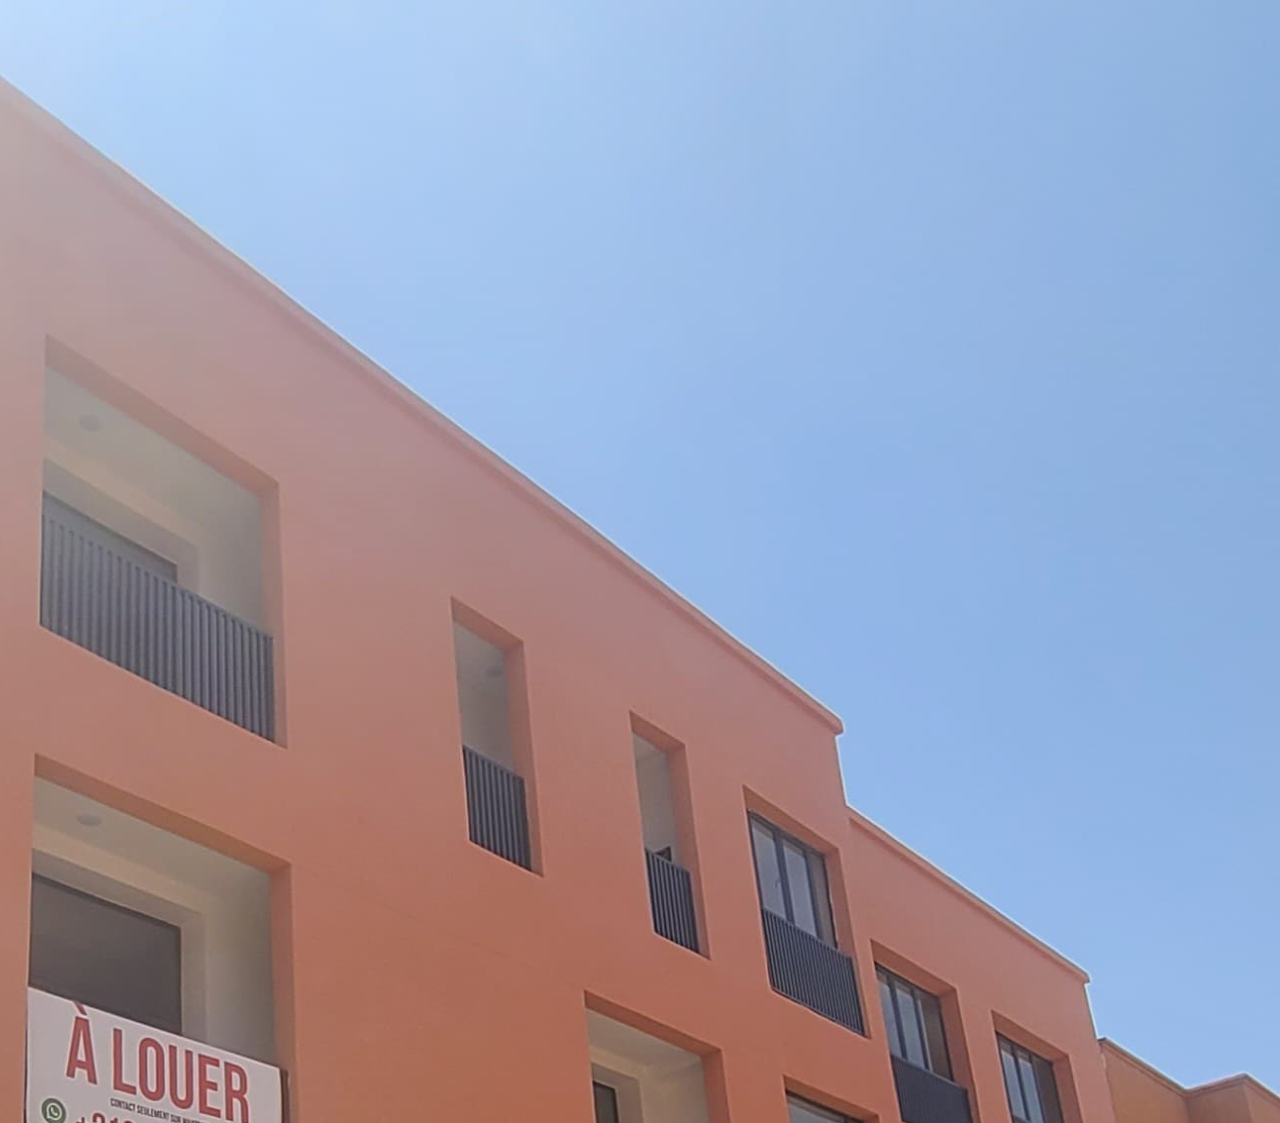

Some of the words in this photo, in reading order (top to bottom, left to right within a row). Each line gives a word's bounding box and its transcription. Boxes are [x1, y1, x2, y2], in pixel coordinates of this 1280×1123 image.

[66, 1000, 98, 1086] À
[109, 1097, 136, 1112] CONTACT
[136, 1104, 170, 1120] SEULEMENT
[170, 1113, 182, 1123] SUR
